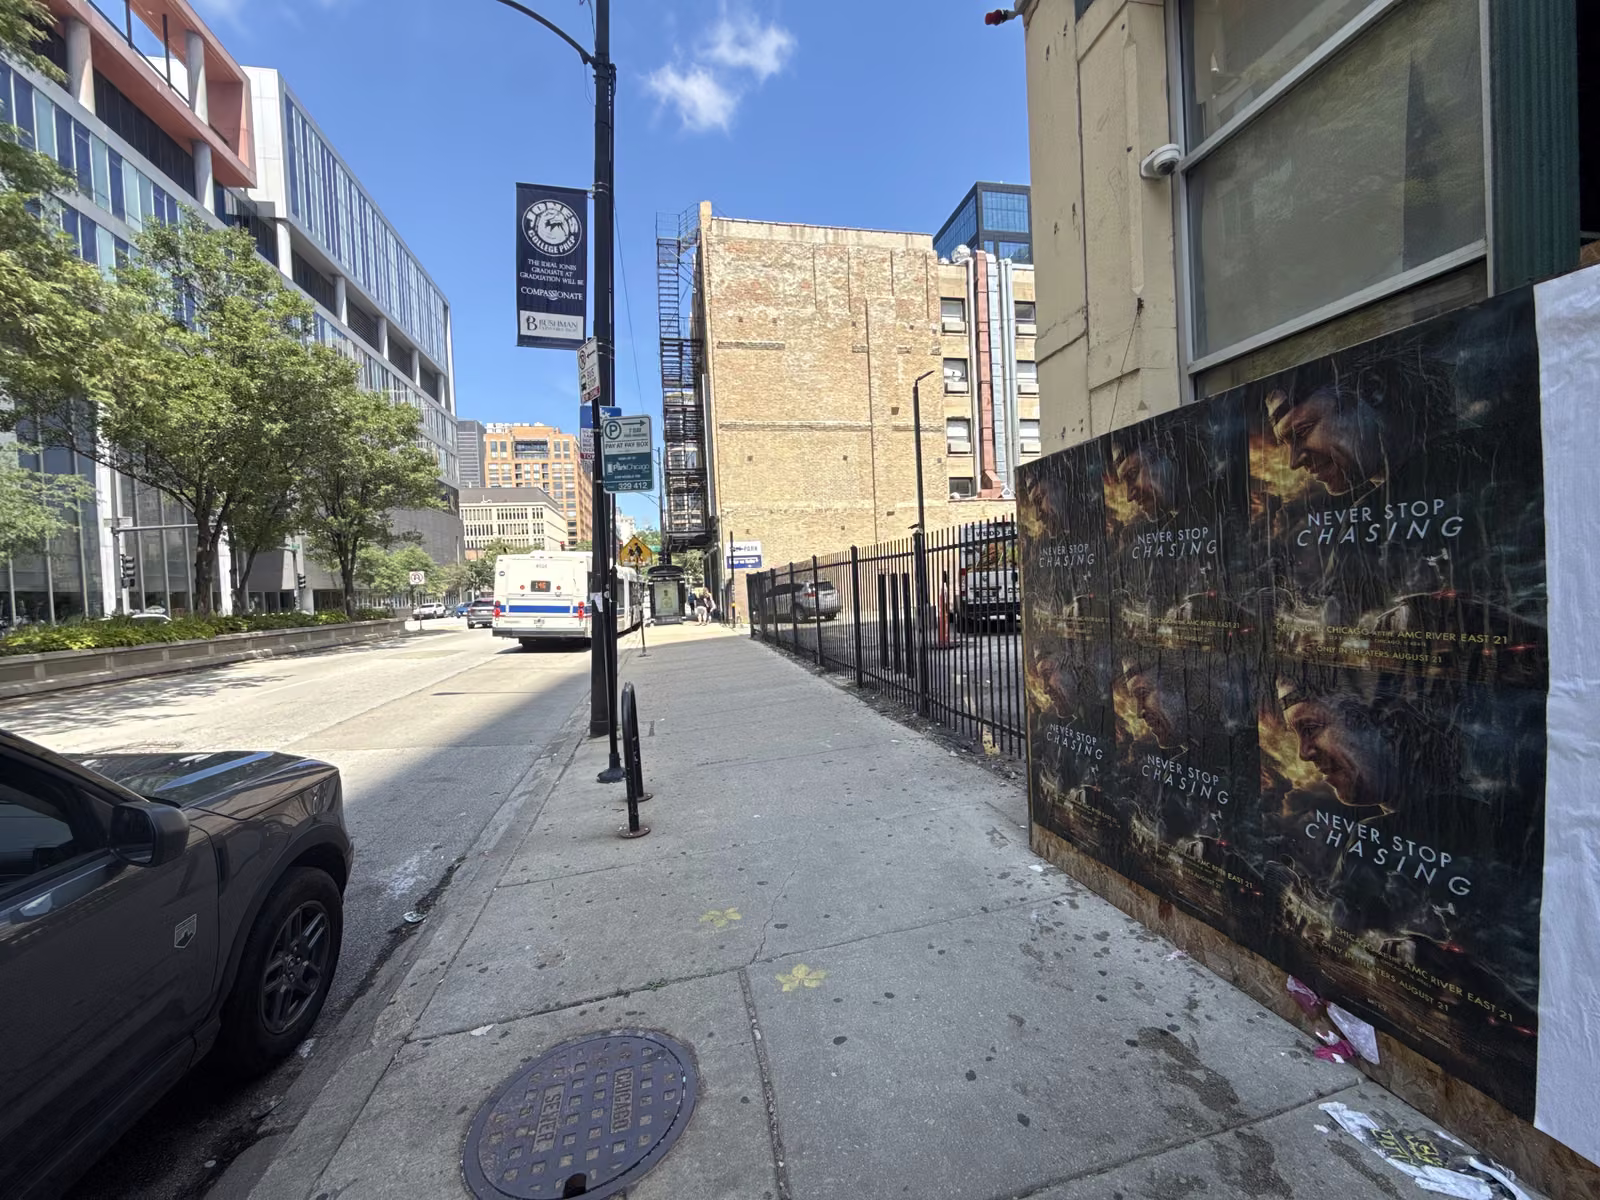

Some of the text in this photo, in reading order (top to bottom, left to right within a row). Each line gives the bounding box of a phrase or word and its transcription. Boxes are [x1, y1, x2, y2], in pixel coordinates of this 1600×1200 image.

[526, 202, 578, 233] JONES
[528, 229, 576, 253] COLLEGE PREP
[519, 271, 560, 282] GRADUATION
[531, 266, 563, 274] GRADUATE
[541, 260, 557, 268] IDEAL
[559, 263, 577, 271] JONES
[520, 286, 583, 300] COMPASSIONATE
[618, 482, 632, 490] 329
[1307, 498, 1446, 526] NEVER STOP
[1137, 527, 1209, 545] NEVER STOP
[1296, 515, 1464, 547] CHASING
[1038, 553, 1095, 569] CHASING
[1041, 543, 1089, 557] NEVER STOP
[1131, 540, 1217, 560] CHASING
[1326, 626, 1370, 636] CHICAGO
[1397, 631, 1423, 639] AMC
[1425, 632, 1456, 641] RIVER
[1461, 633, 1489, 643] EAST
[1493, 635, 1508, 645] 21
[1316, 645, 1335, 653] ONLY
[1338, 646, 1347, 654] IN
[1392, 652, 1430, 662] AUGUST
[1431, 655, 1442, 664] 21
[1046, 731, 1103, 760] CHASING
[1050, 723, 1097, 746] NEVER STOP
[1147, 753, 1220, 785] NEVER STOP
[1141, 764, 1230, 805] CHASING
[1316, 809, 1452, 868] NEVER STOP
[1305, 823, 1472, 896] CHASING
[1227, 872, 1244, 884] EAST
[1244, 881, 1253, 889] 21
[1399, 980, 1434, 1005] AUGUST
[1437, 1001, 1449, 1012] 21
[1404, 962, 1428, 980] AMC
[1430, 975, 1463, 997] RIVER
[1467, 992, 1496, 1013] EAST
[1499, 1009, 1513, 1022] 21
[613, 1071, 633, 1130] CHICAGO
[537, 1094, 562, 1143] SEWER
